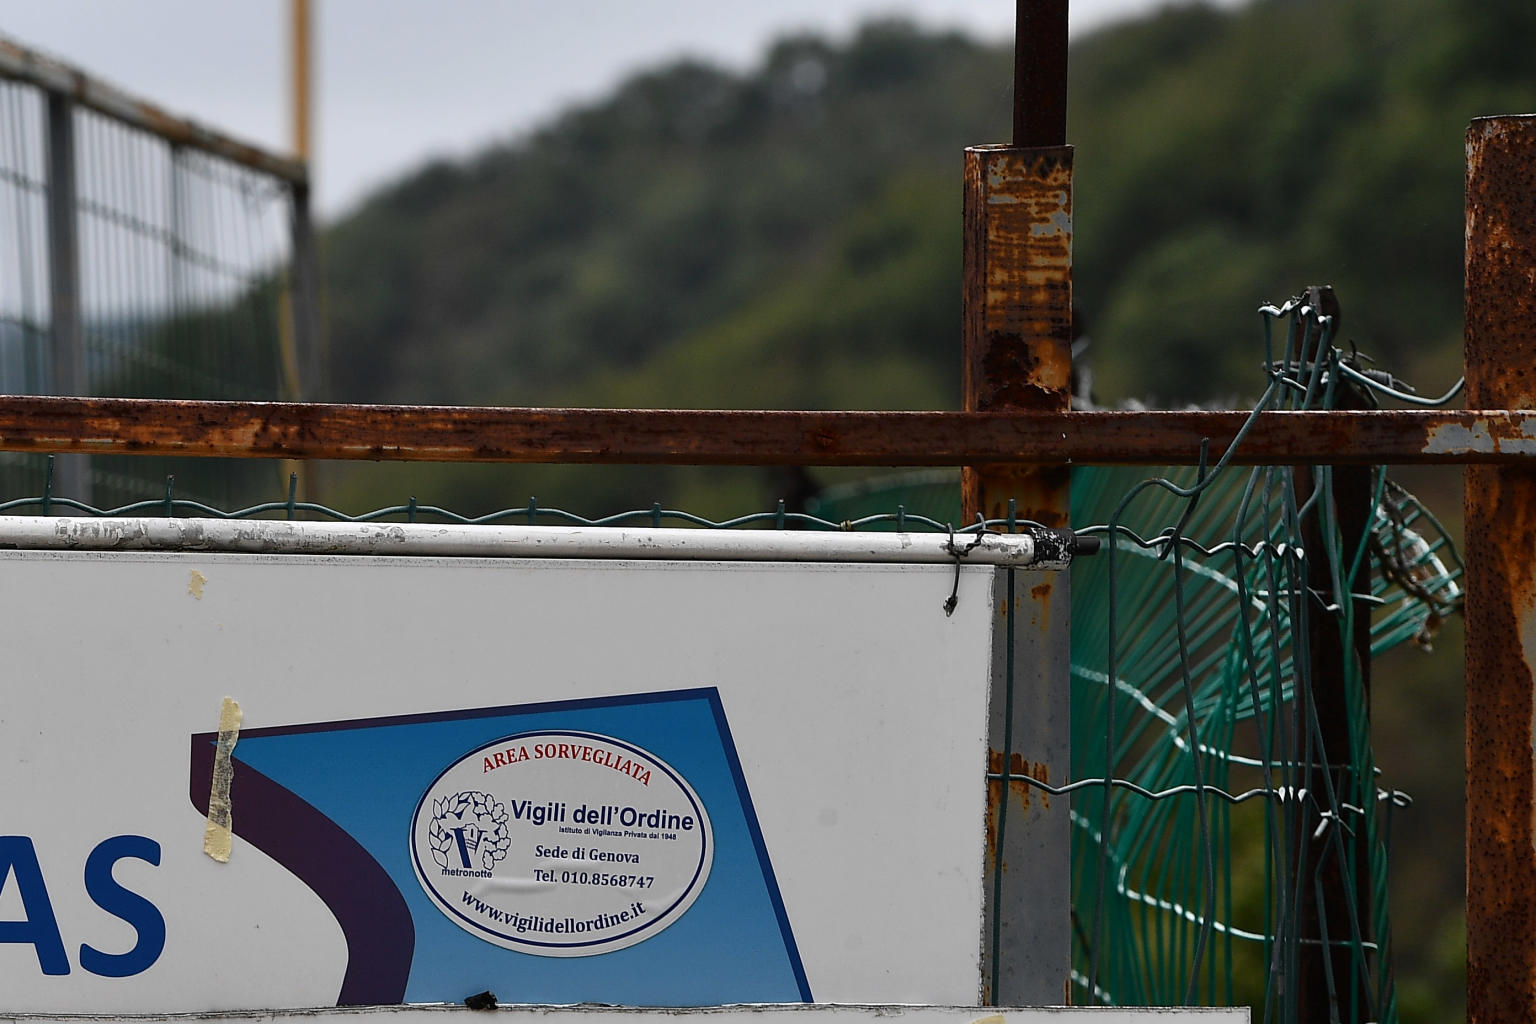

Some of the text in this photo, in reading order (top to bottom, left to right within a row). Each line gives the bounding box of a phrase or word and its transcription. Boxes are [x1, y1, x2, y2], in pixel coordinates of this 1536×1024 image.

[482, 743, 652, 786] AREA SORVEGLIATA
[511, 799, 566, 826] Vigili
[592, 829, 622, 837] Vigilanza
[624, 830, 648, 839] Privata
[535, 845, 640, 864] Sede di Genova
[441, 868, 493, 878] metronotte
[533, 869, 655, 889] Tel. 010.8568747
[462, 890, 647, 934] www.vigilidellordine.it
